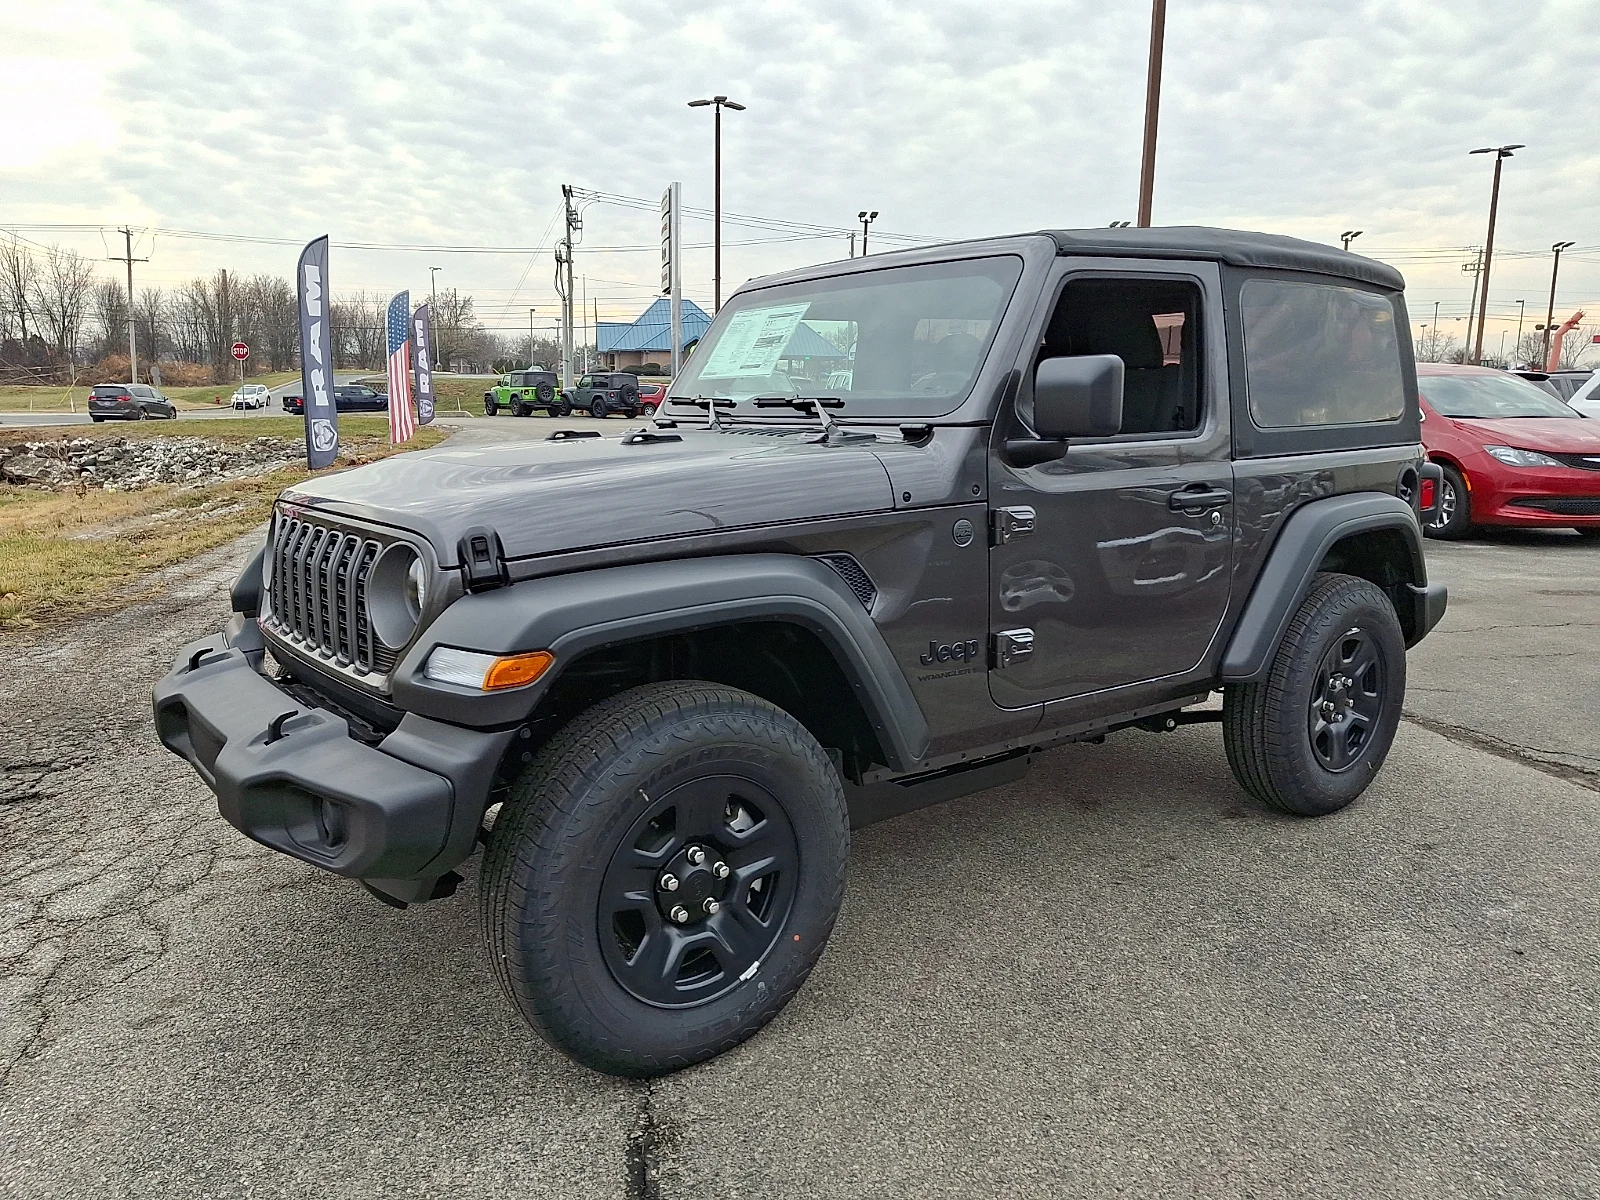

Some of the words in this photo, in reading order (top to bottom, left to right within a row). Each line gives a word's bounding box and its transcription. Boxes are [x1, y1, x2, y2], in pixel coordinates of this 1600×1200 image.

[233, 347, 248, 355] STOP
[304, 264, 329, 406] RAM
[414, 319, 430, 394] RAM
[920, 639, 979, 666] Jeep
